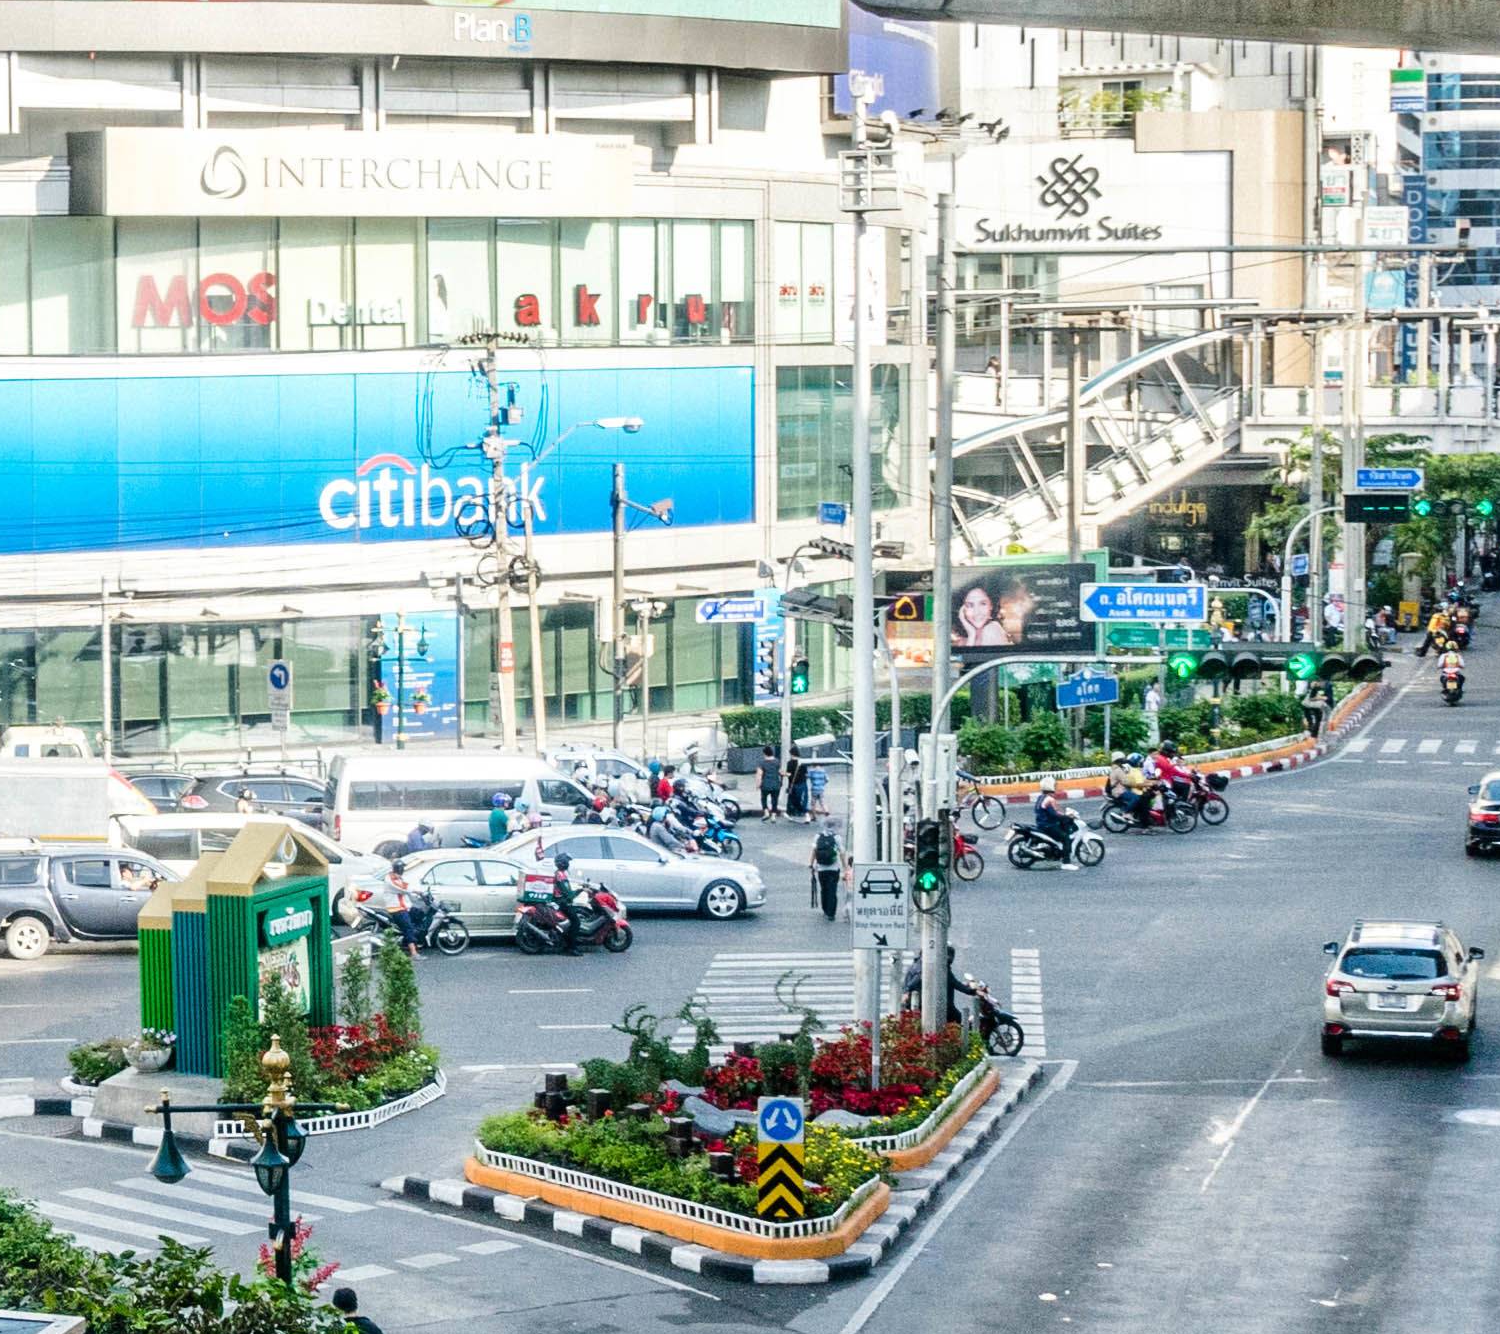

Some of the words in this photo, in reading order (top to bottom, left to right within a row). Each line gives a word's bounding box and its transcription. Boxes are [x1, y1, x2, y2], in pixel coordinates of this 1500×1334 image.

[453, 11, 508, 42] Plan
[514, 13, 532, 43] B
[262, 154, 554, 195] INTERCHANGE
[975, 218, 1091, 244] Sukhumvit
[1098, 216, 1163, 243] Suites
[131, 271, 276, 328] MOS
[319, 461, 547, 530] citibank
[1148, 489, 1208, 527] indulge
[1099, 594, 1113, 605] ถ.
[1115, 587, 1198, 606] อโศกมนตรี
[1179, 571, 1241, 589] Shumvit
[1243, 573, 1279, 589] Suites
